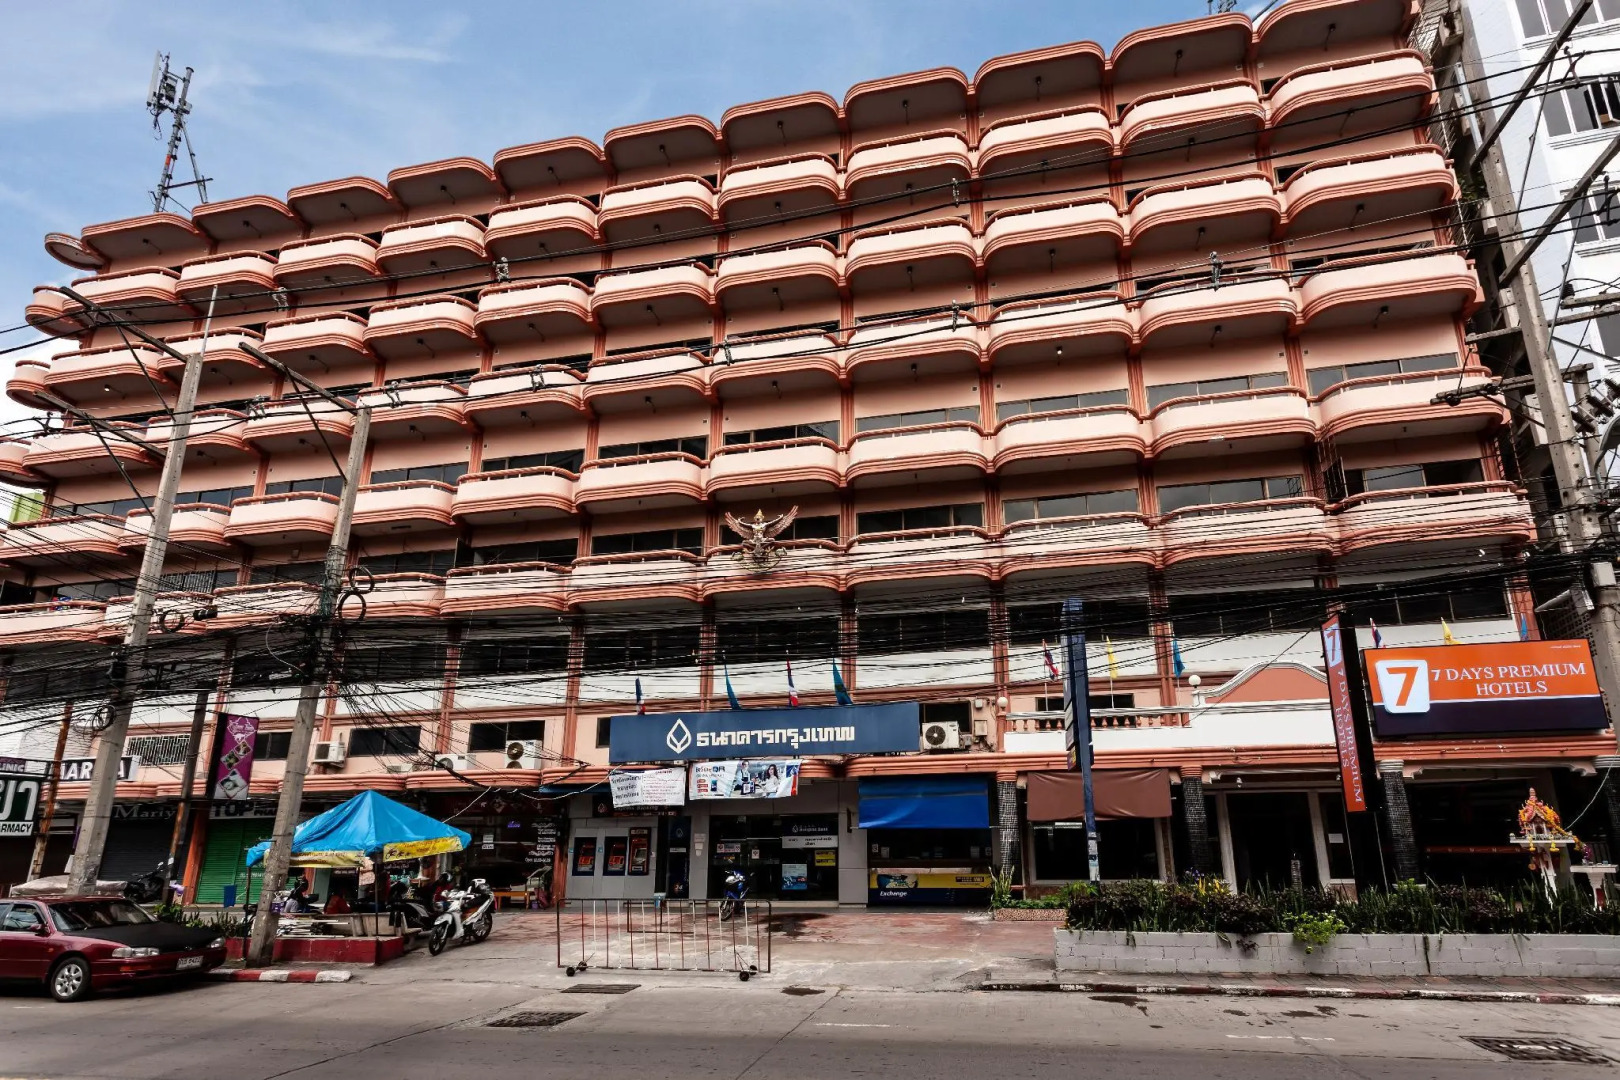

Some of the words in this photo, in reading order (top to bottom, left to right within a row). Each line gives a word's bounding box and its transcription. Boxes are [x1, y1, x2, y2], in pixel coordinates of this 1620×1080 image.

[1386, 666, 1418, 706] 7
[1431, 669, 1441, 681] 7
[1445, 666, 1494, 681] DAYS
[1497, 662, 1587, 678] PREMIUM
[1476, 680, 1548, 696] HOTELS
[696, 726, 855, 749] ธนาคารกรุงเทพ
[1335, 707, 1349, 767] HOTELS
[1339, 681, 1351, 722] DAYS
[1345, 726, 1362, 802] PREMIUM
